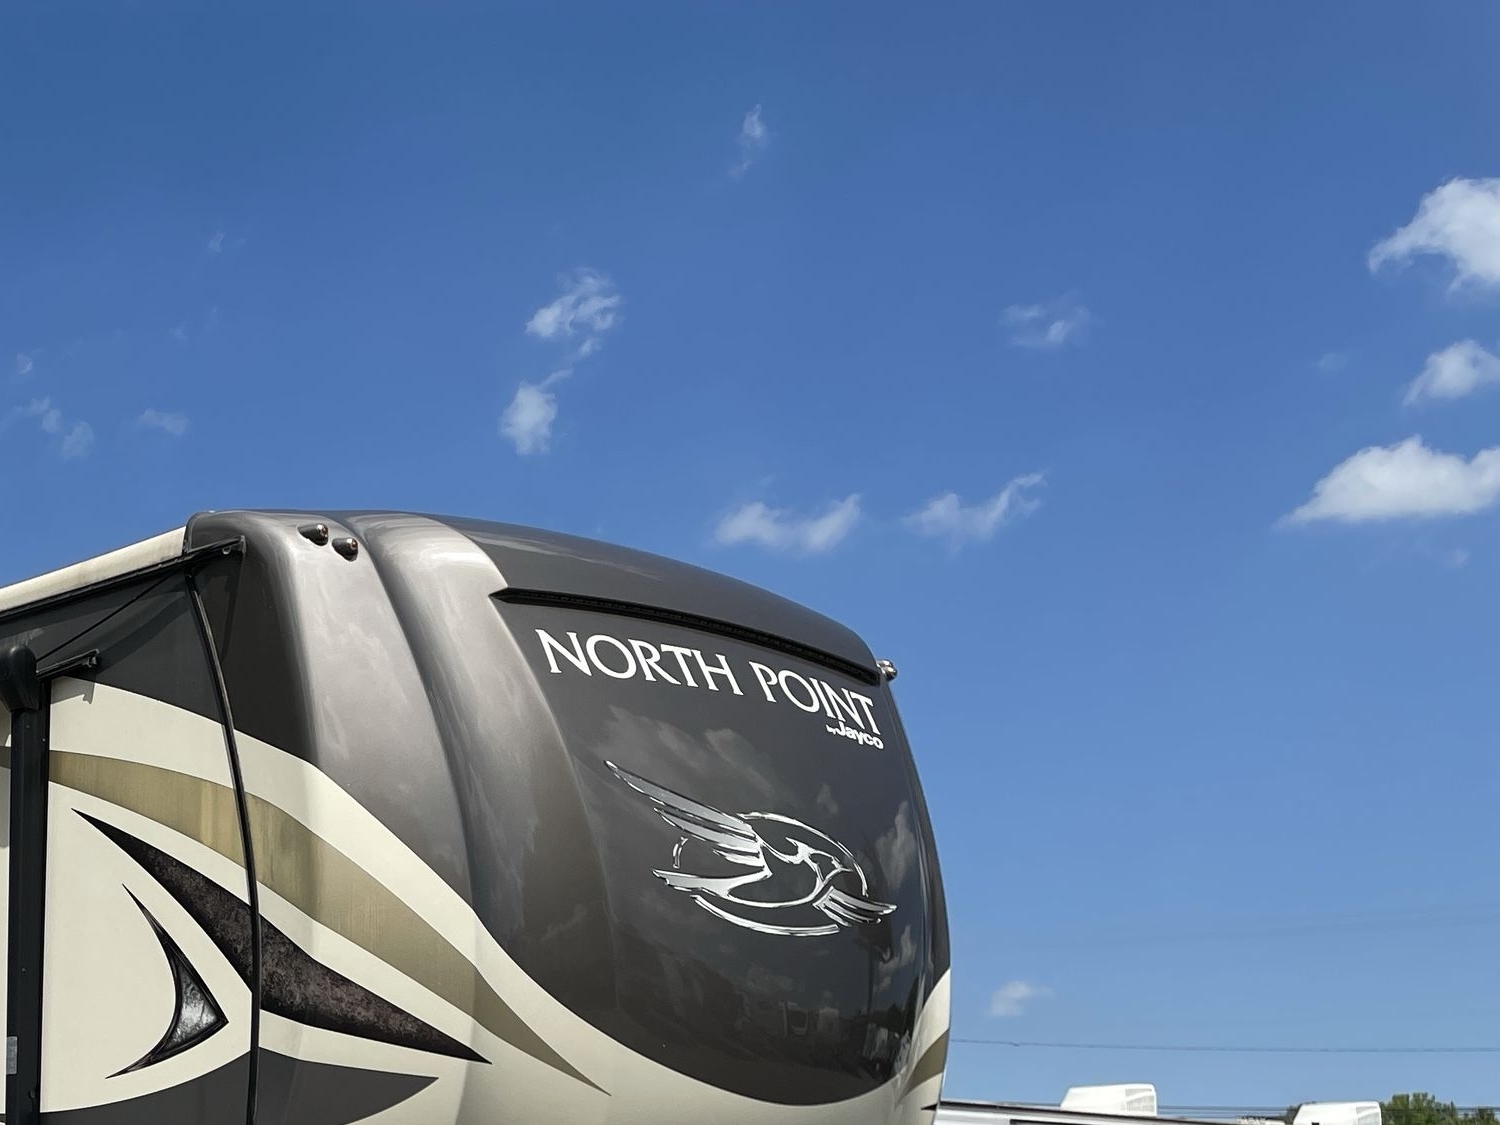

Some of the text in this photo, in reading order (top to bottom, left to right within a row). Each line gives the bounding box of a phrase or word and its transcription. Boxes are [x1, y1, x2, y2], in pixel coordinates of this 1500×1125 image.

[535, 629, 881, 735] NORTH POINT
[836, 721, 884, 750] Jayco
